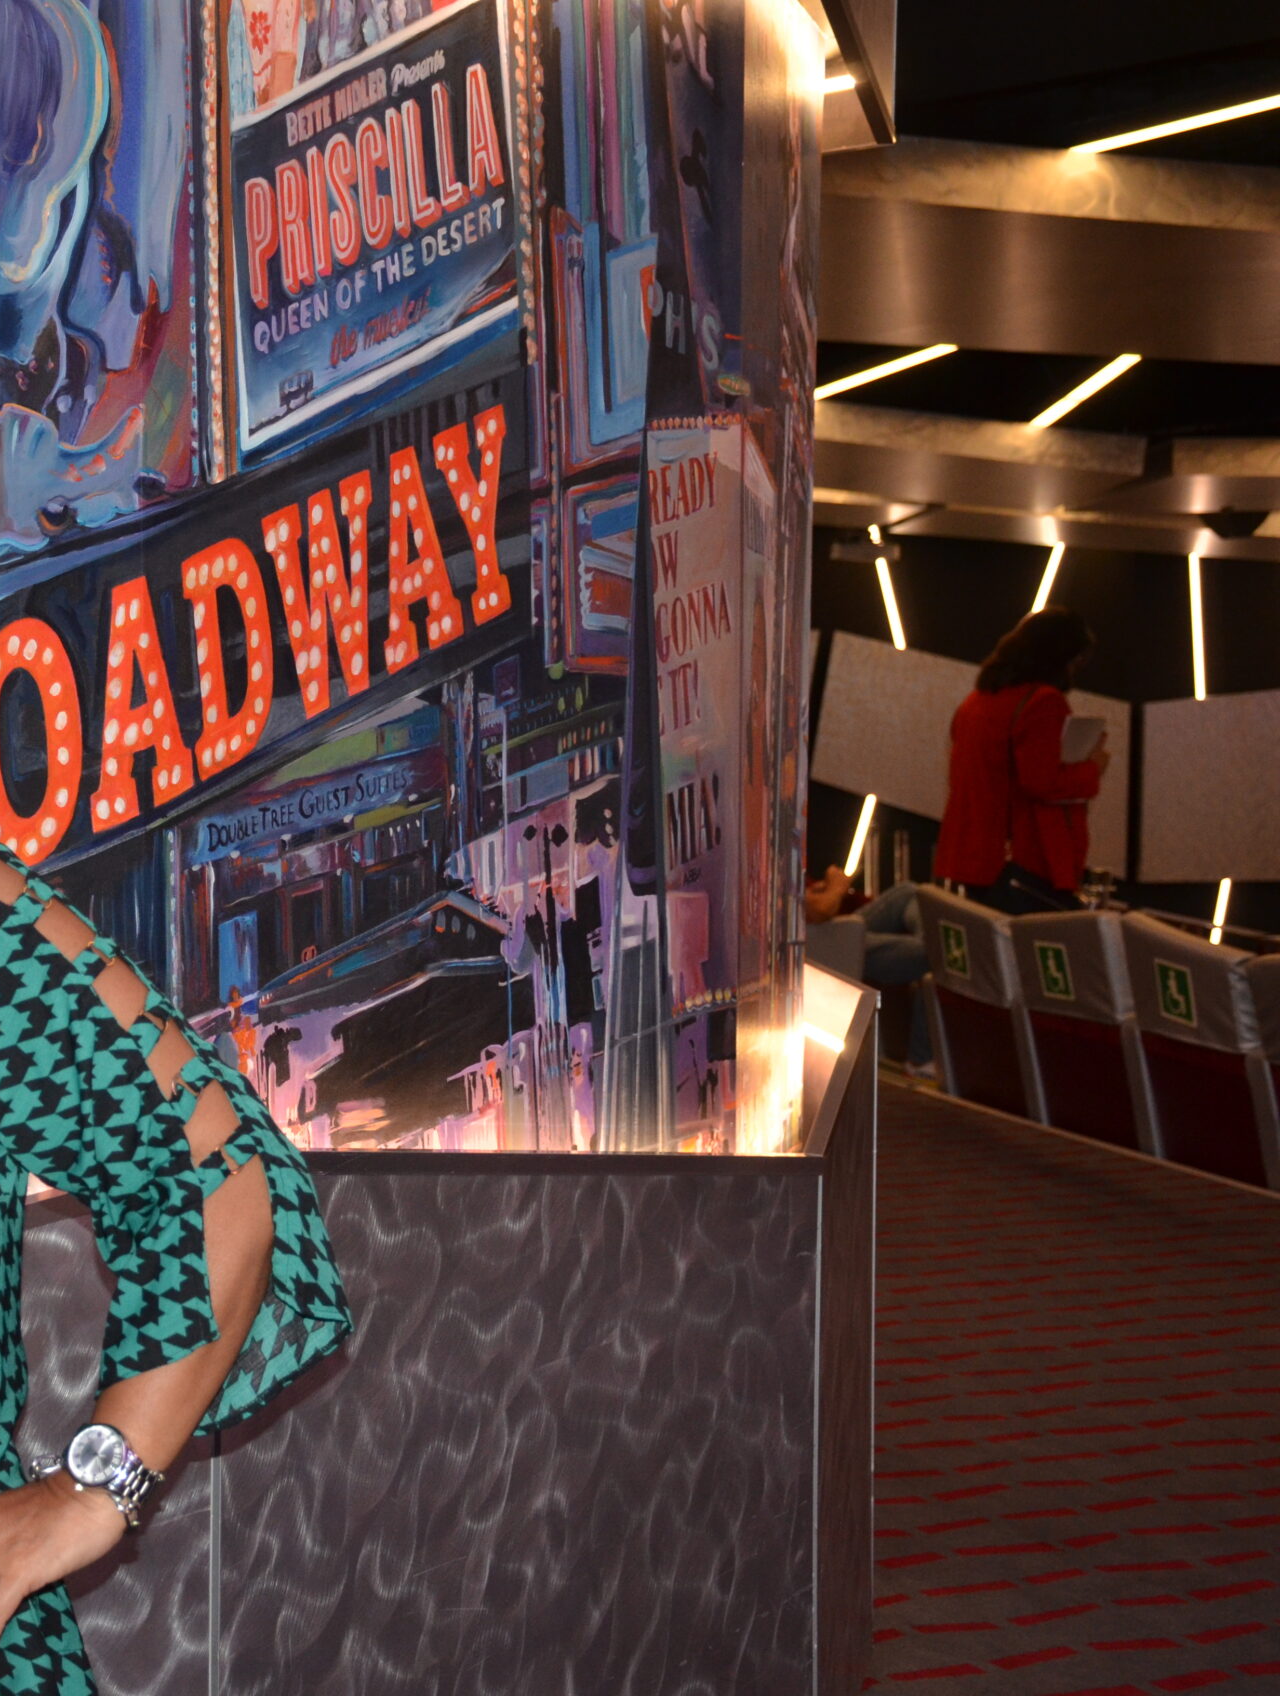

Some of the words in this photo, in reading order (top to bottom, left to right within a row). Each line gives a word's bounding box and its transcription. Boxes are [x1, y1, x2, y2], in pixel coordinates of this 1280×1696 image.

[244, 63, 504, 310] PRISCILLA
[253, 289, 329, 354] QUEEN
[336, 269, 368, 311] OF
[371, 243, 417, 294] THE
[421, 197, 506, 267] DESERT
[656, 580, 732, 664] GONNA
